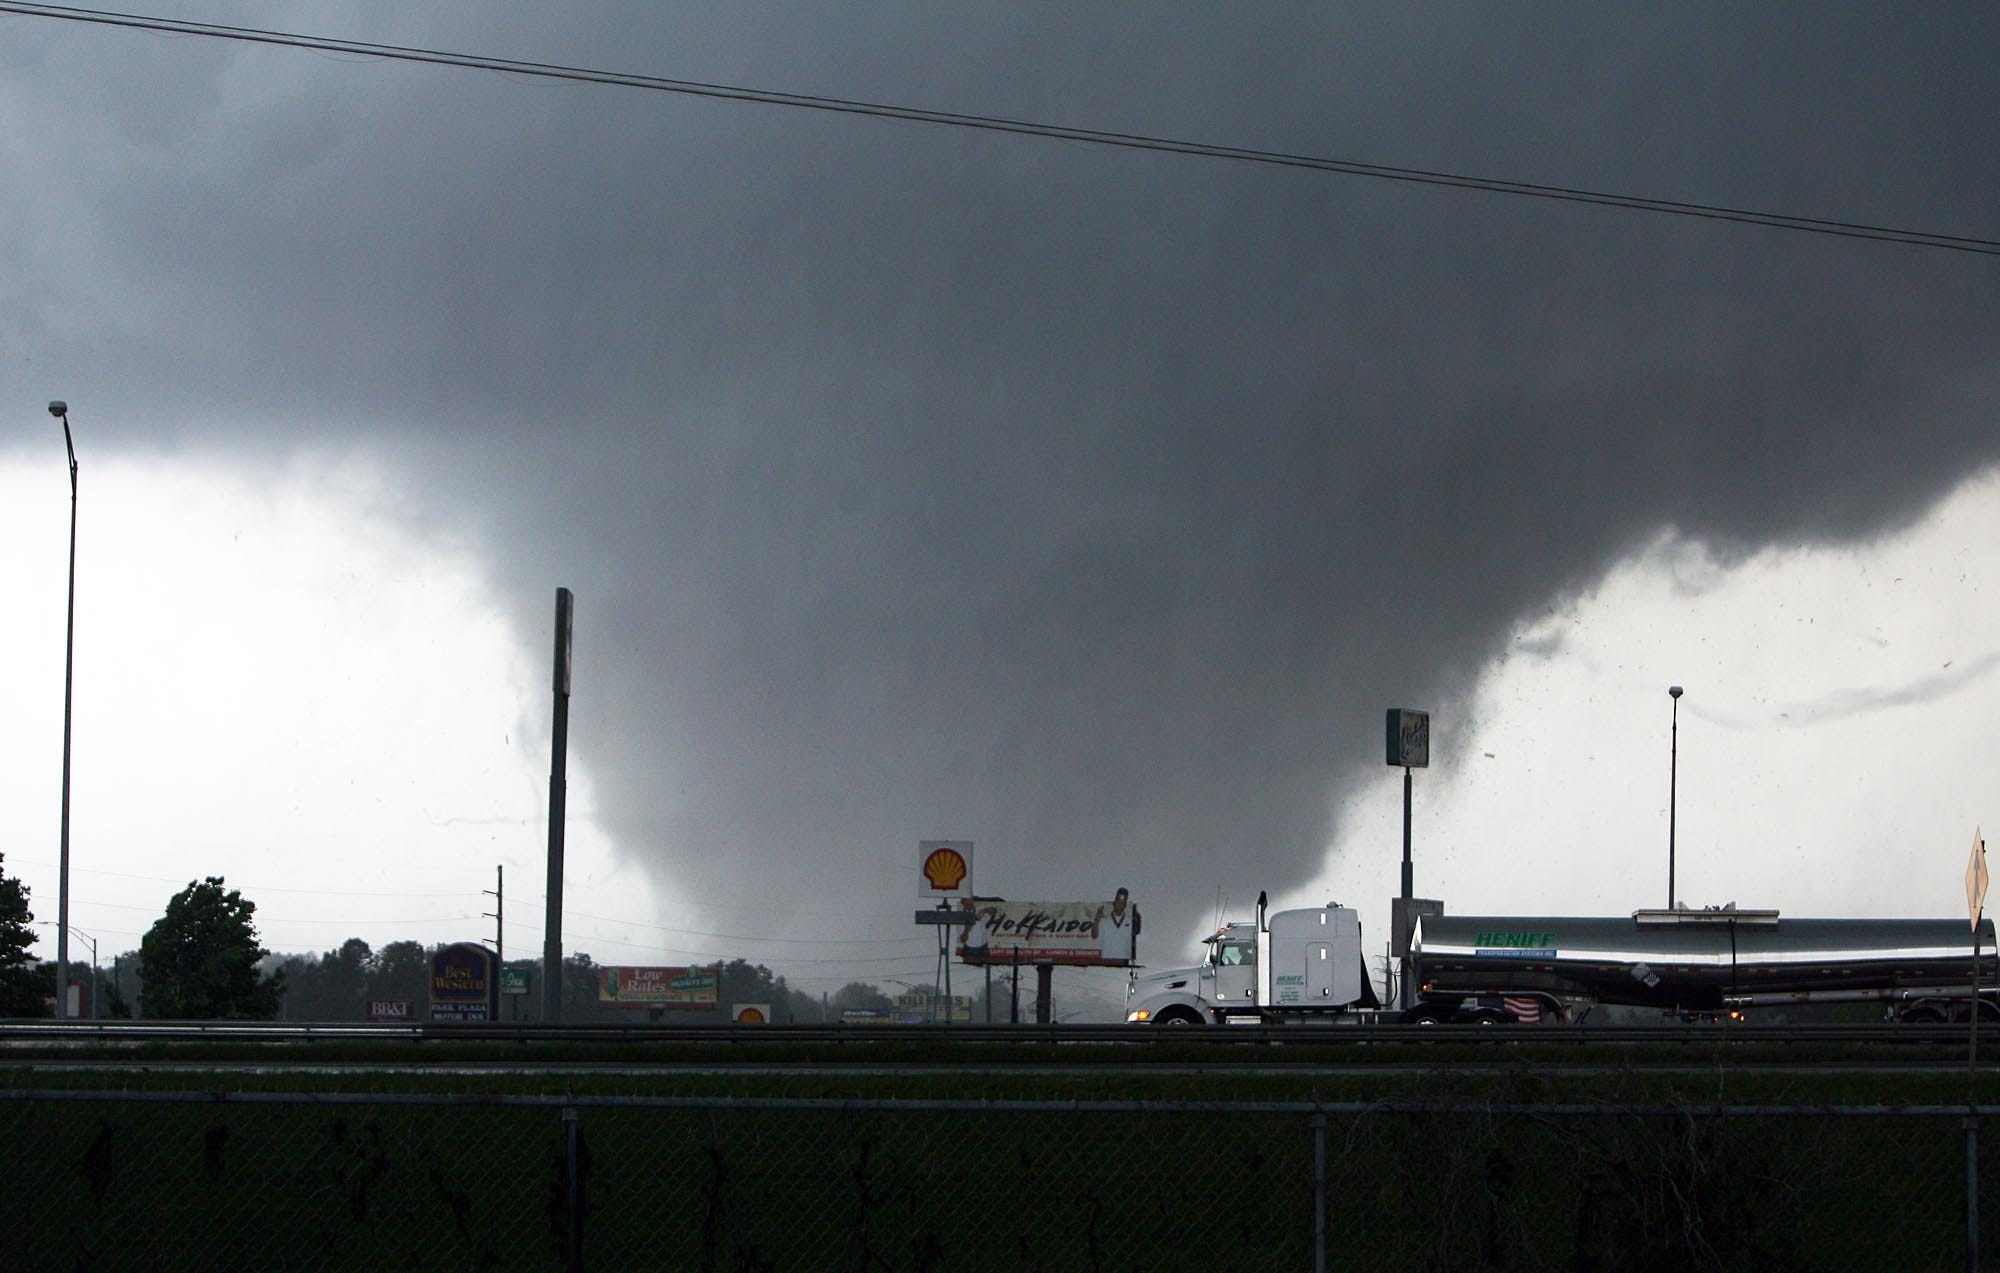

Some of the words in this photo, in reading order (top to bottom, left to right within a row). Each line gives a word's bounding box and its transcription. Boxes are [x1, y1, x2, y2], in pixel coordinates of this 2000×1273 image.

[1475, 931, 1555, 946] HENIFF
[445, 966, 471, 978] Best
[634, 969, 662, 981] Low
[435, 977, 484, 990] Western
[627, 980, 666, 992] Rates
[371, 1001, 410, 1016] BB&T
[431, 1003, 454, 1011] PARK
[457, 1003, 487, 1011] PLAZA
